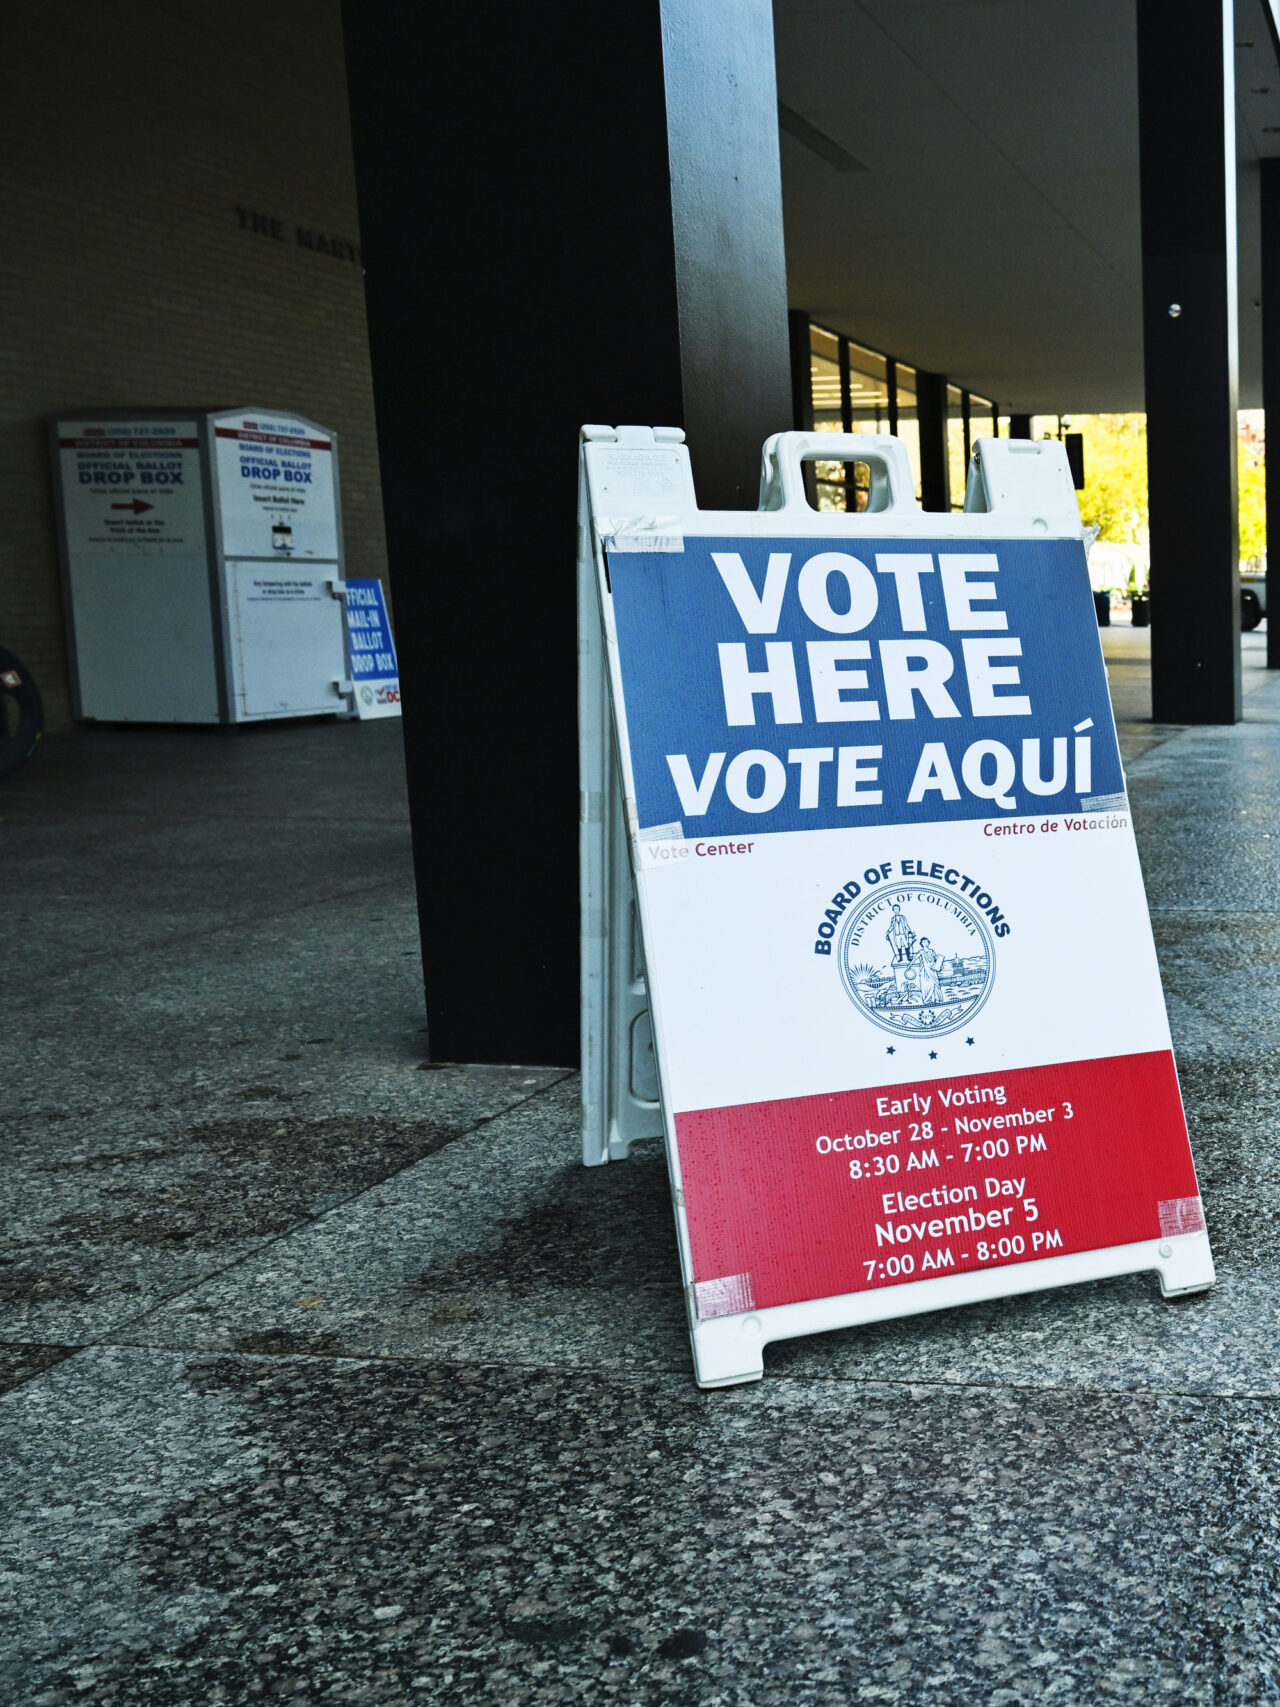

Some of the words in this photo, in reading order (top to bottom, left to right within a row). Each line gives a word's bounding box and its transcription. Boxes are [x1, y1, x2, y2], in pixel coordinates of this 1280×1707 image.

[238, 443, 264, 453] BOARD
[265, 446, 274, 454] OF
[276, 447, 312, 458] ELECTIONS
[240, 456, 278, 467] OFFICIAL
[281, 460, 312, 470] BALLOT
[77, 462, 132, 470] OFFICIAL
[136, 462, 184, 470] BALLOT
[79, 472, 135, 484] DROP
[140, 472, 184, 484] BOX
[241, 466, 280, 480] DROP
[284, 470, 312, 484] BOX
[347, 588, 379, 606] FFICIAL
[710, 552, 1009, 634] VOTE
[348, 610, 380, 628] MAIL-IN
[351, 631, 384, 650] BALLOT
[351, 654, 374, 673] DROP
[375, 652, 395, 672] BOX
[717, 636, 1032, 727] HERE
[665, 744, 883, 816] VOTE
[907, 717, 1094, 810] AQUÍ
[983, 818, 1036, 837] Centro
[1039, 818, 1058, 834] de
[1063, 814, 1128, 833] Votación
[648, 843, 690, 862] Vote
[695, 839, 755, 858] Center
[814, 880, 862, 956] BOARD
[864, 862, 894, 886] OF
[900, 860, 1011, 938] ELECTIONS
[850, 898, 894, 947] DISTRICT
[896, 893, 914, 903] OF
[917, 892, 976, 936] COLUMBIA
[876, 1092, 932, 1118] Early
[937, 1085, 1008, 1108] Voting
[815, 1126, 901, 1155] October
[908, 1122, 934, 1142] 28
[954, 1105, 1056, 1136] November
[1062, 1102, 1074, 1120] 3
[848, 1154, 900, 1180] 8:30
[906, 1148, 940, 1172] AM
[960, 1138, 1010, 1163] 7:00
[1016, 1132, 1048, 1154] PM
[882, 1184, 978, 1216] Election
[984, 1177, 1027, 1198] Day
[874, 1206, 1014, 1248] November
[1023, 1198, 1040, 1222] 5
[862, 1254, 915, 1281] 7:00
[921, 1247, 956, 1272] AM
[976, 1235, 1026, 1262] 8:00
[1031, 1229, 1064, 1252] PM
